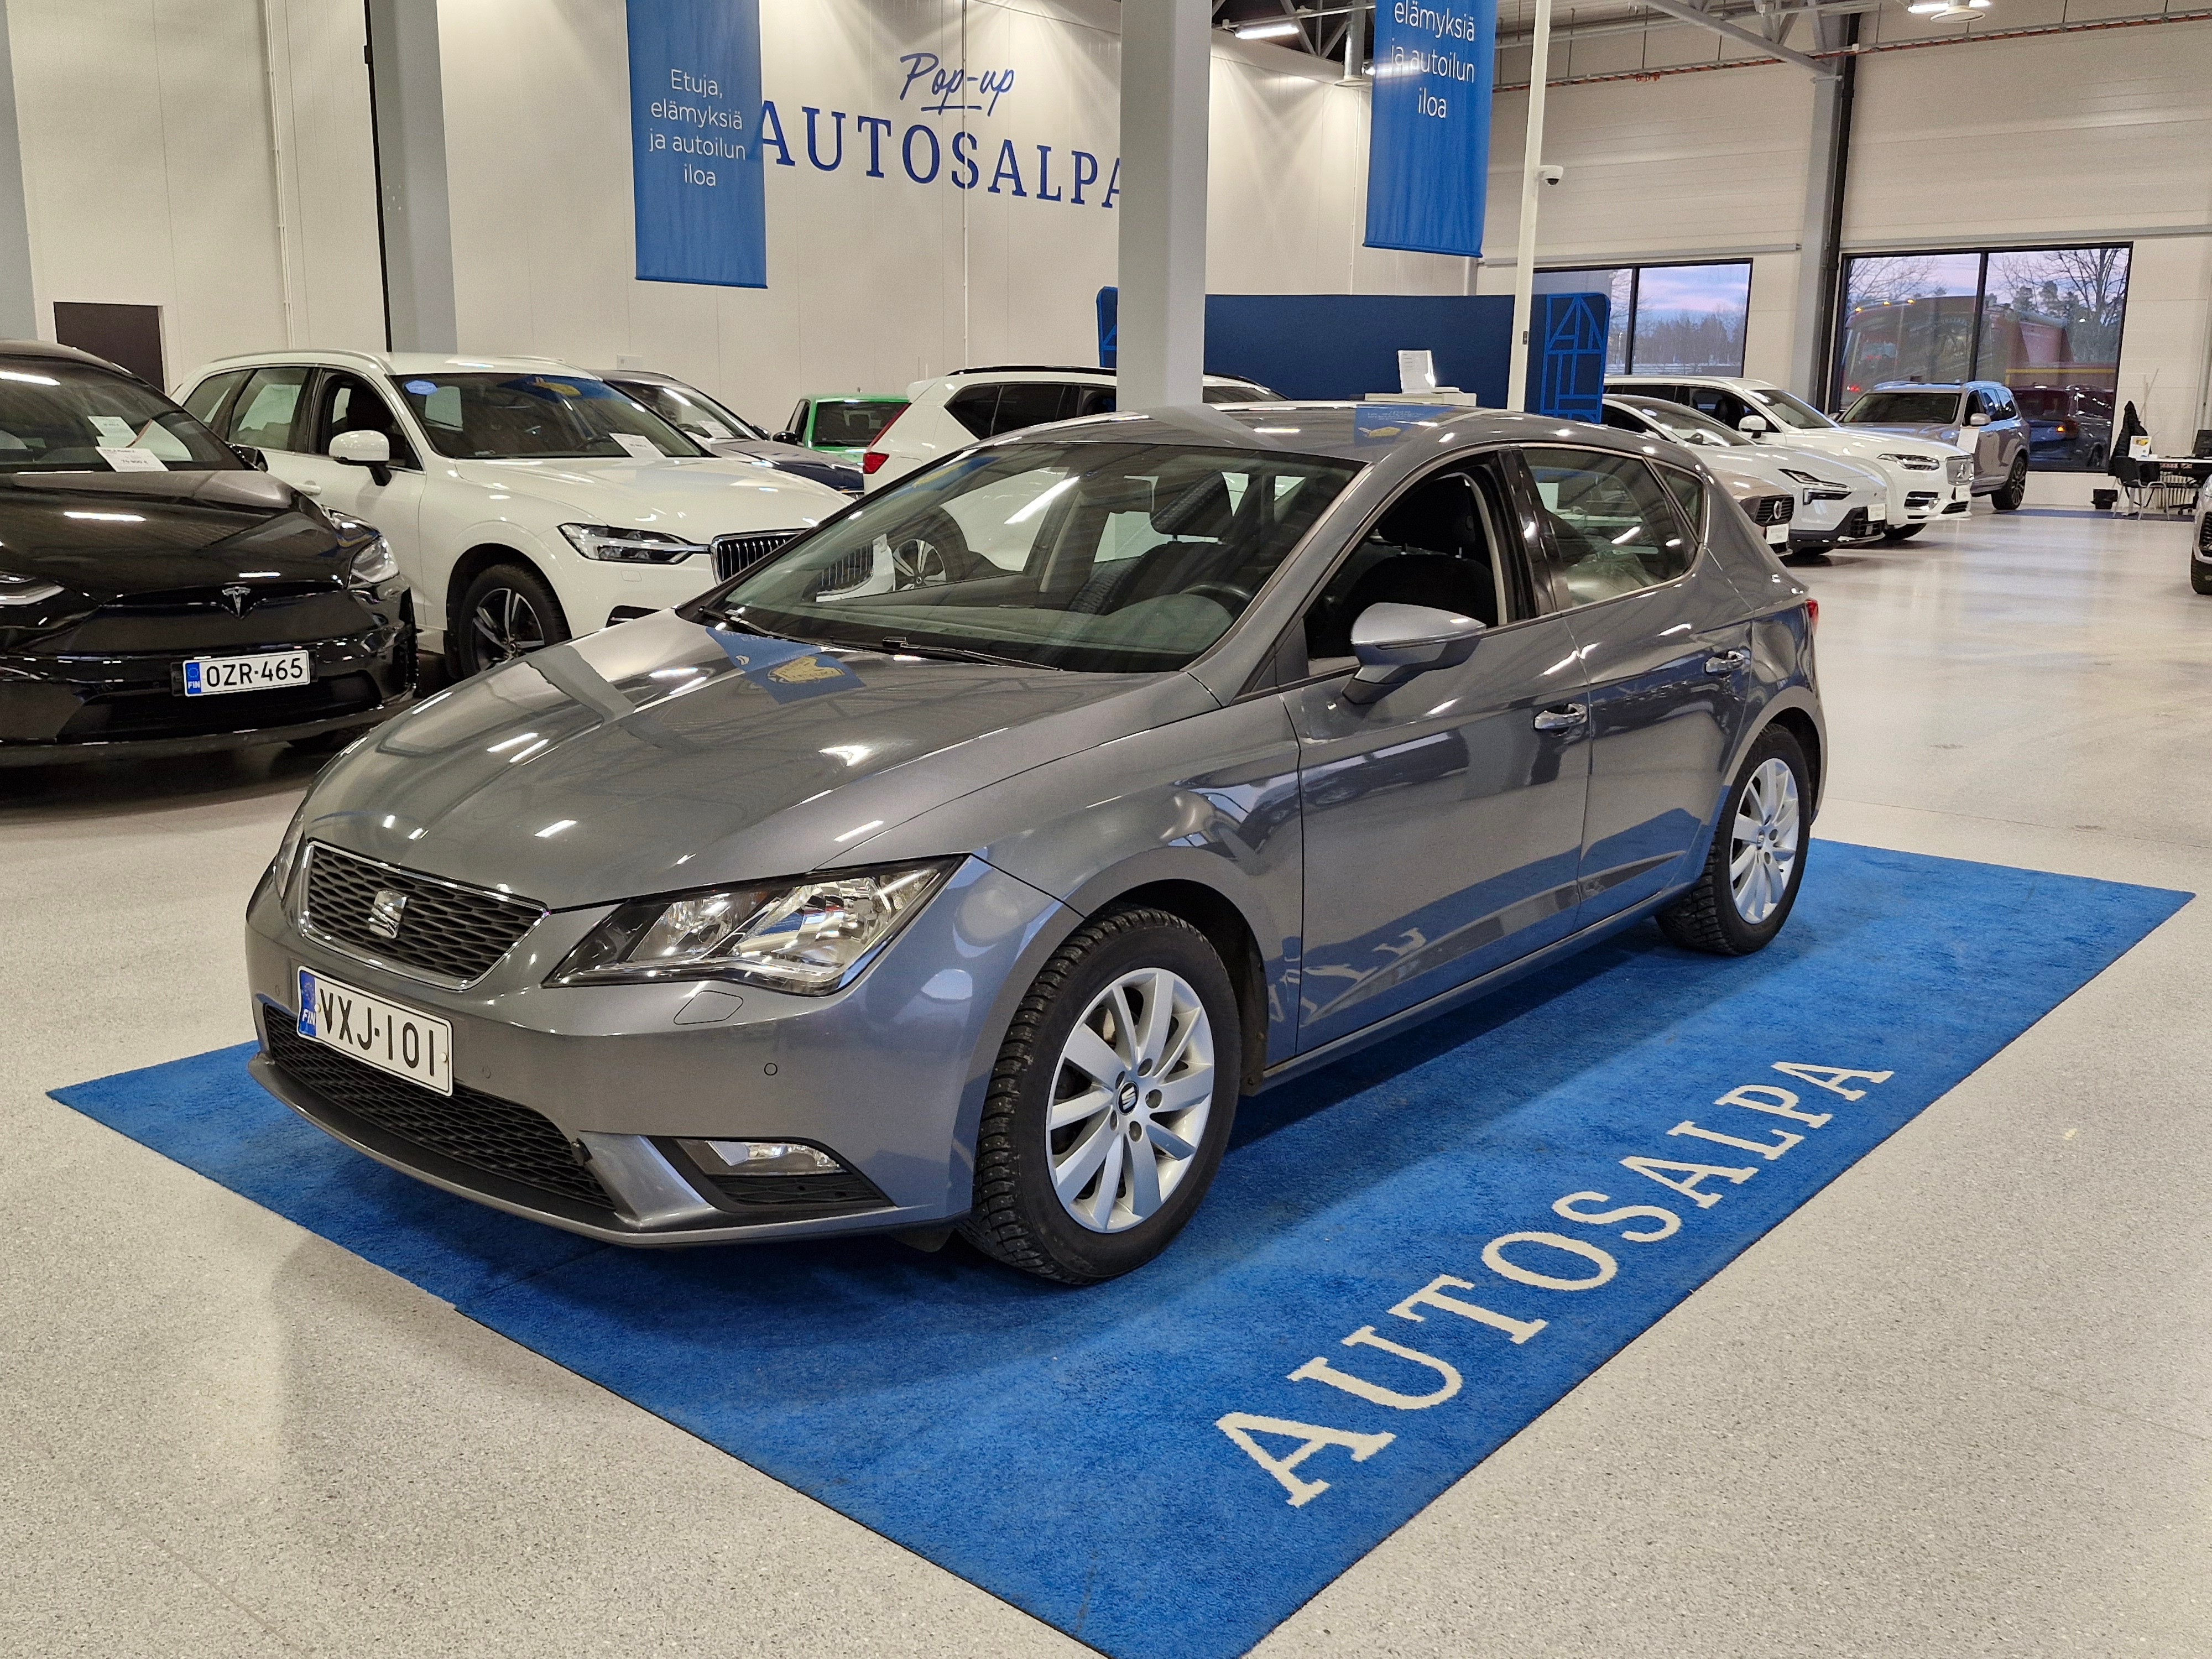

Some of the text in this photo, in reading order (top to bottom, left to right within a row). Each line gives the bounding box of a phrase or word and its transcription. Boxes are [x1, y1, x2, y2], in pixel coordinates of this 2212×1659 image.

[1394, 0, 1474, 41] elämyksiä
[1390, 38, 1474, 83] ja autoilun
[671, 69, 723, 98] Etuja,
[900, 53, 1014, 116] Pop-up
[651, 98, 743, 130] elämyksiä
[1418, 87, 1447, 118] iloa
[649, 128, 746, 160] ja autoilun
[684, 163, 716, 186] iloa
[187, 681, 200, 690] FIN
[206, 658, 303, 687] OZR-465
[302, 1008, 316, 1025] FIN
[320, 988, 435, 1077] VXJ-101
[1215, 1061, 1895, 1509] AUTOSALPA
